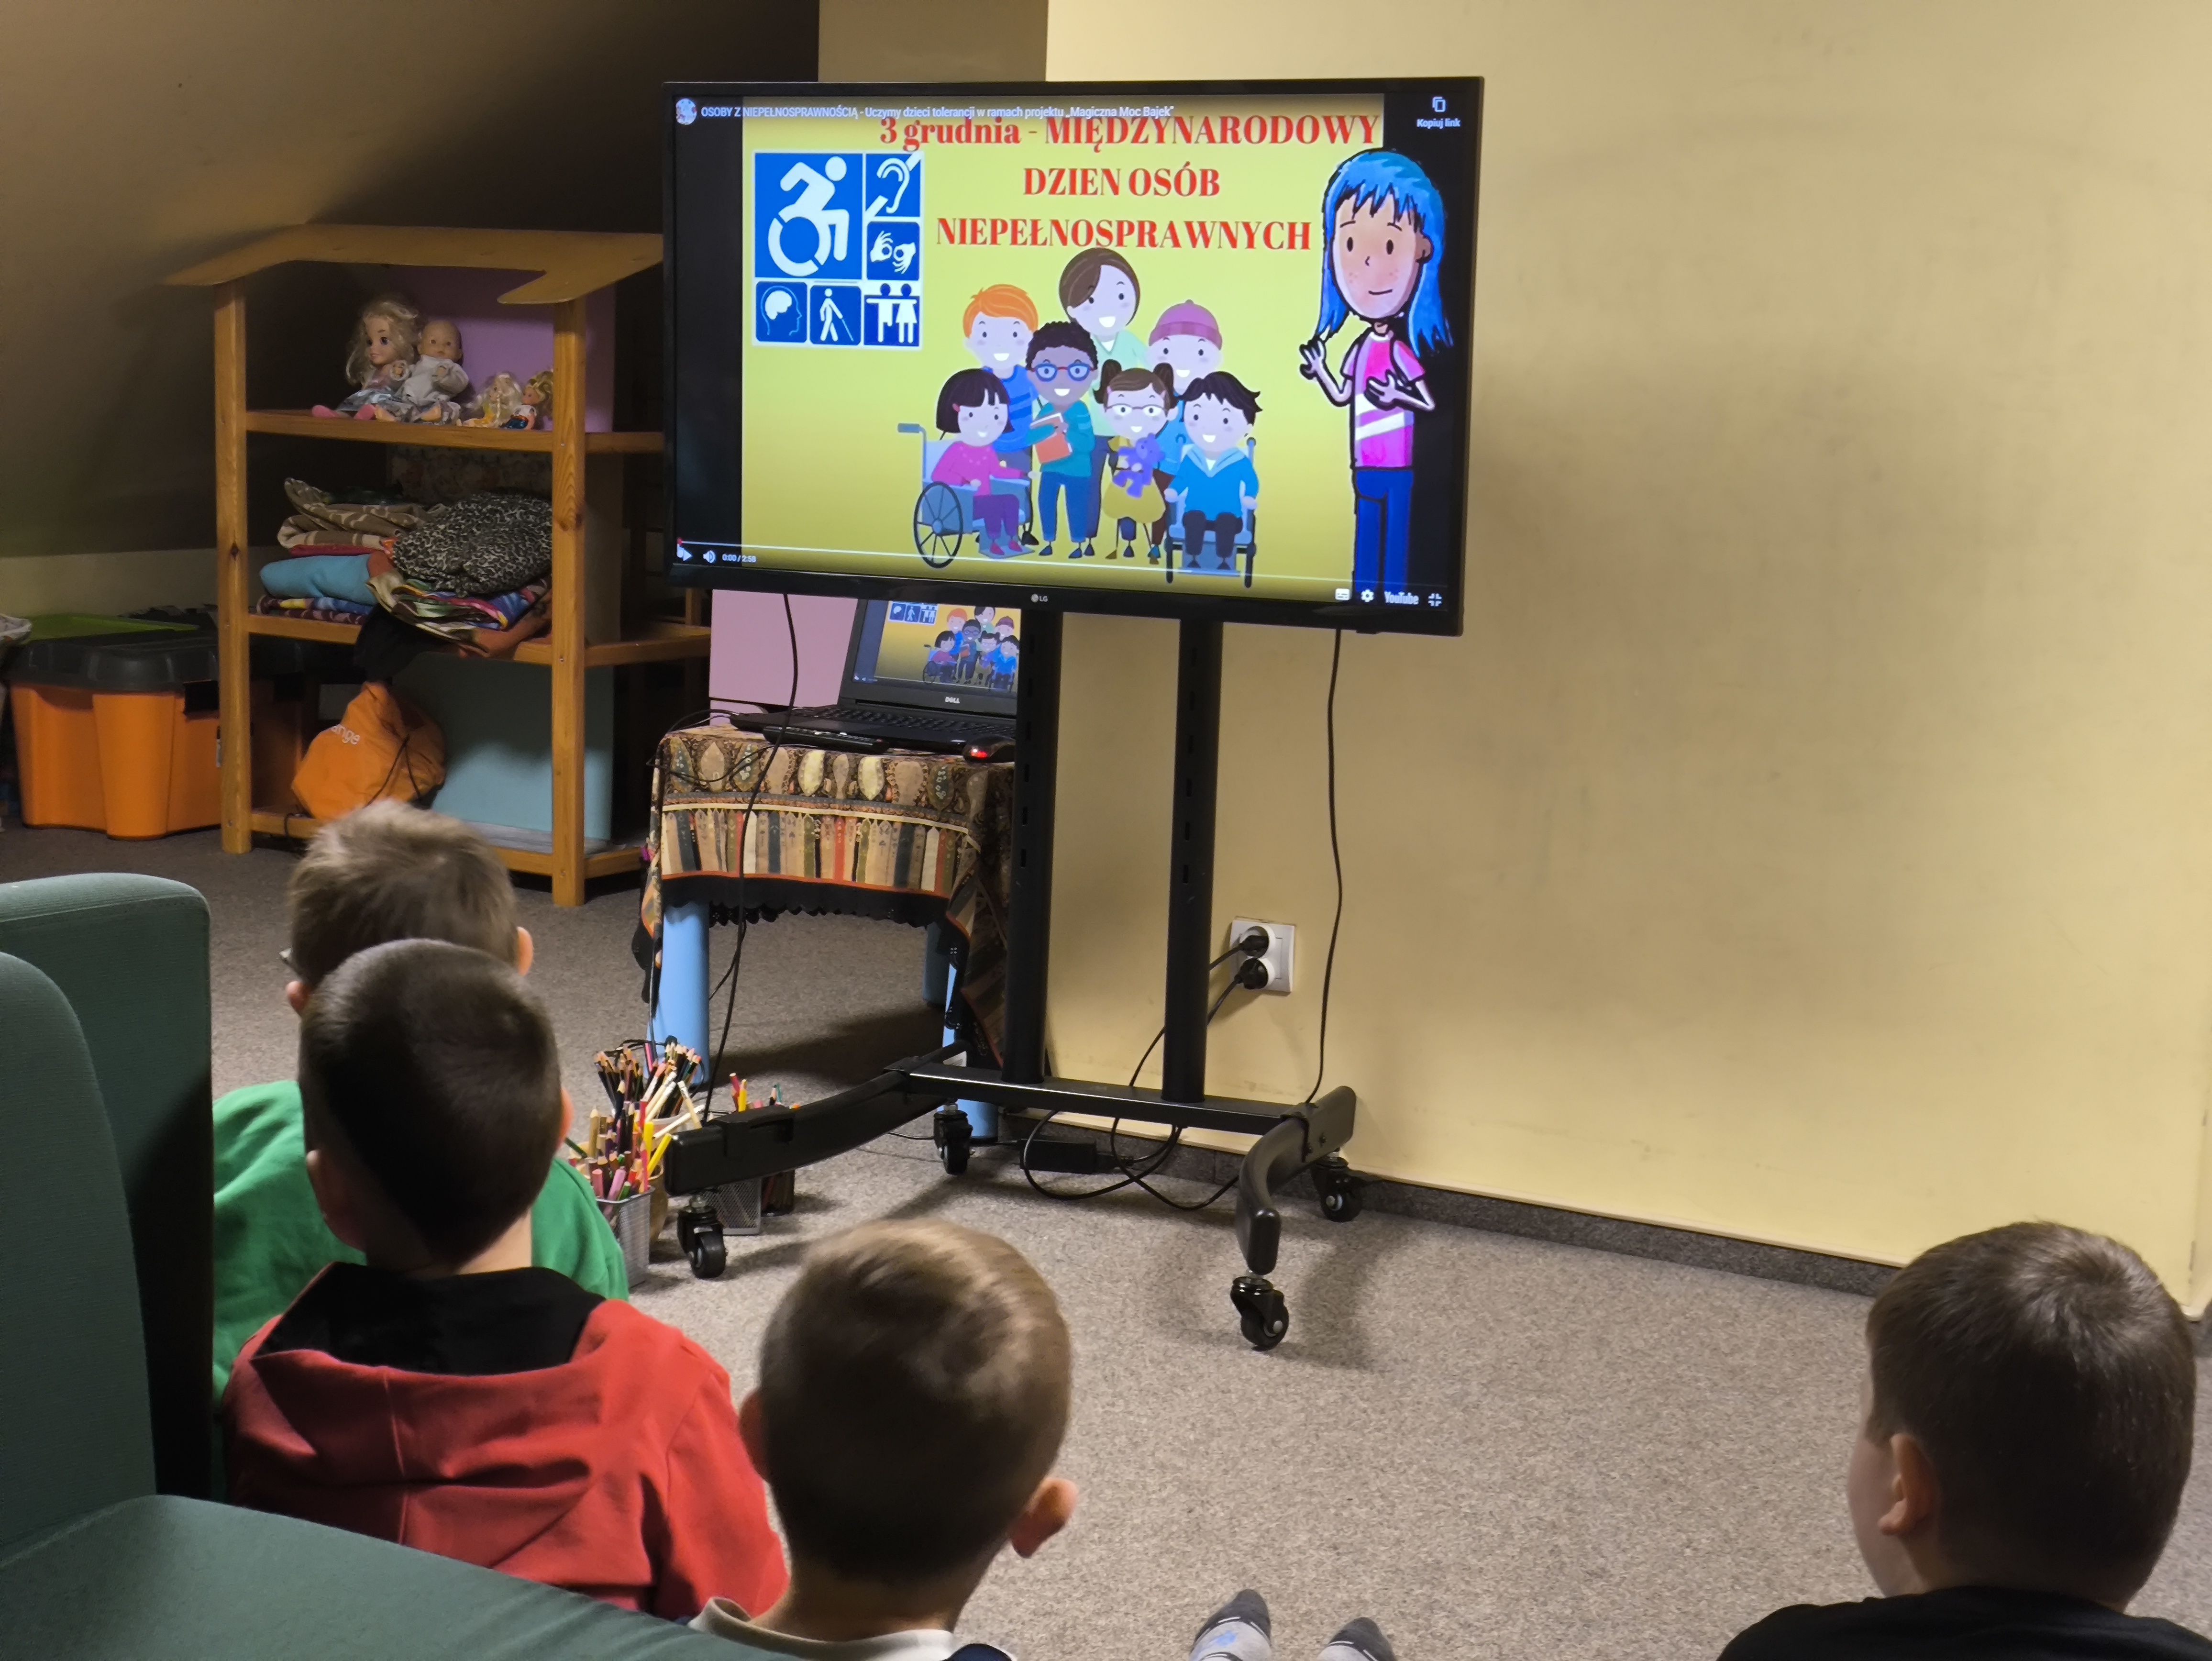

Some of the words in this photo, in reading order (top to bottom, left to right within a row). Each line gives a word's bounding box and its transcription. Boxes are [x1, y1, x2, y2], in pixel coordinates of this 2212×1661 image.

[701, 107, 733, 118] OSOBY
[734, 107, 741, 118] Z
[742, 104, 858, 120] NIEPEŁNOSPRAWNOŚCIĄ
[865, 107, 900, 120] Uczymy
[903, 107, 930, 118] dzieci
[932, 106, 975, 120] tolerancji
[976, 109, 984, 117] w
[987, 106, 1023, 117] ramach
[1025, 106, 1064, 119] projektu
[1119, 106, 1141, 117] Moc
[1416, 118, 1444, 129] Kopiuj
[1445, 117, 1460, 127] link
[880, 116, 897, 144] 3
[902, 116, 1022, 153] grudnia
[1045, 114, 1380, 153] MIĘDZYNARODOWY
[1023, 167, 1122, 196] DZIEN
[1128, 161, 1220, 197] OSÓB
[936, 217, 1312, 250] NIEPEŁNOSPRAWNYCH
[1384, 591, 1419, 605] YouTube
